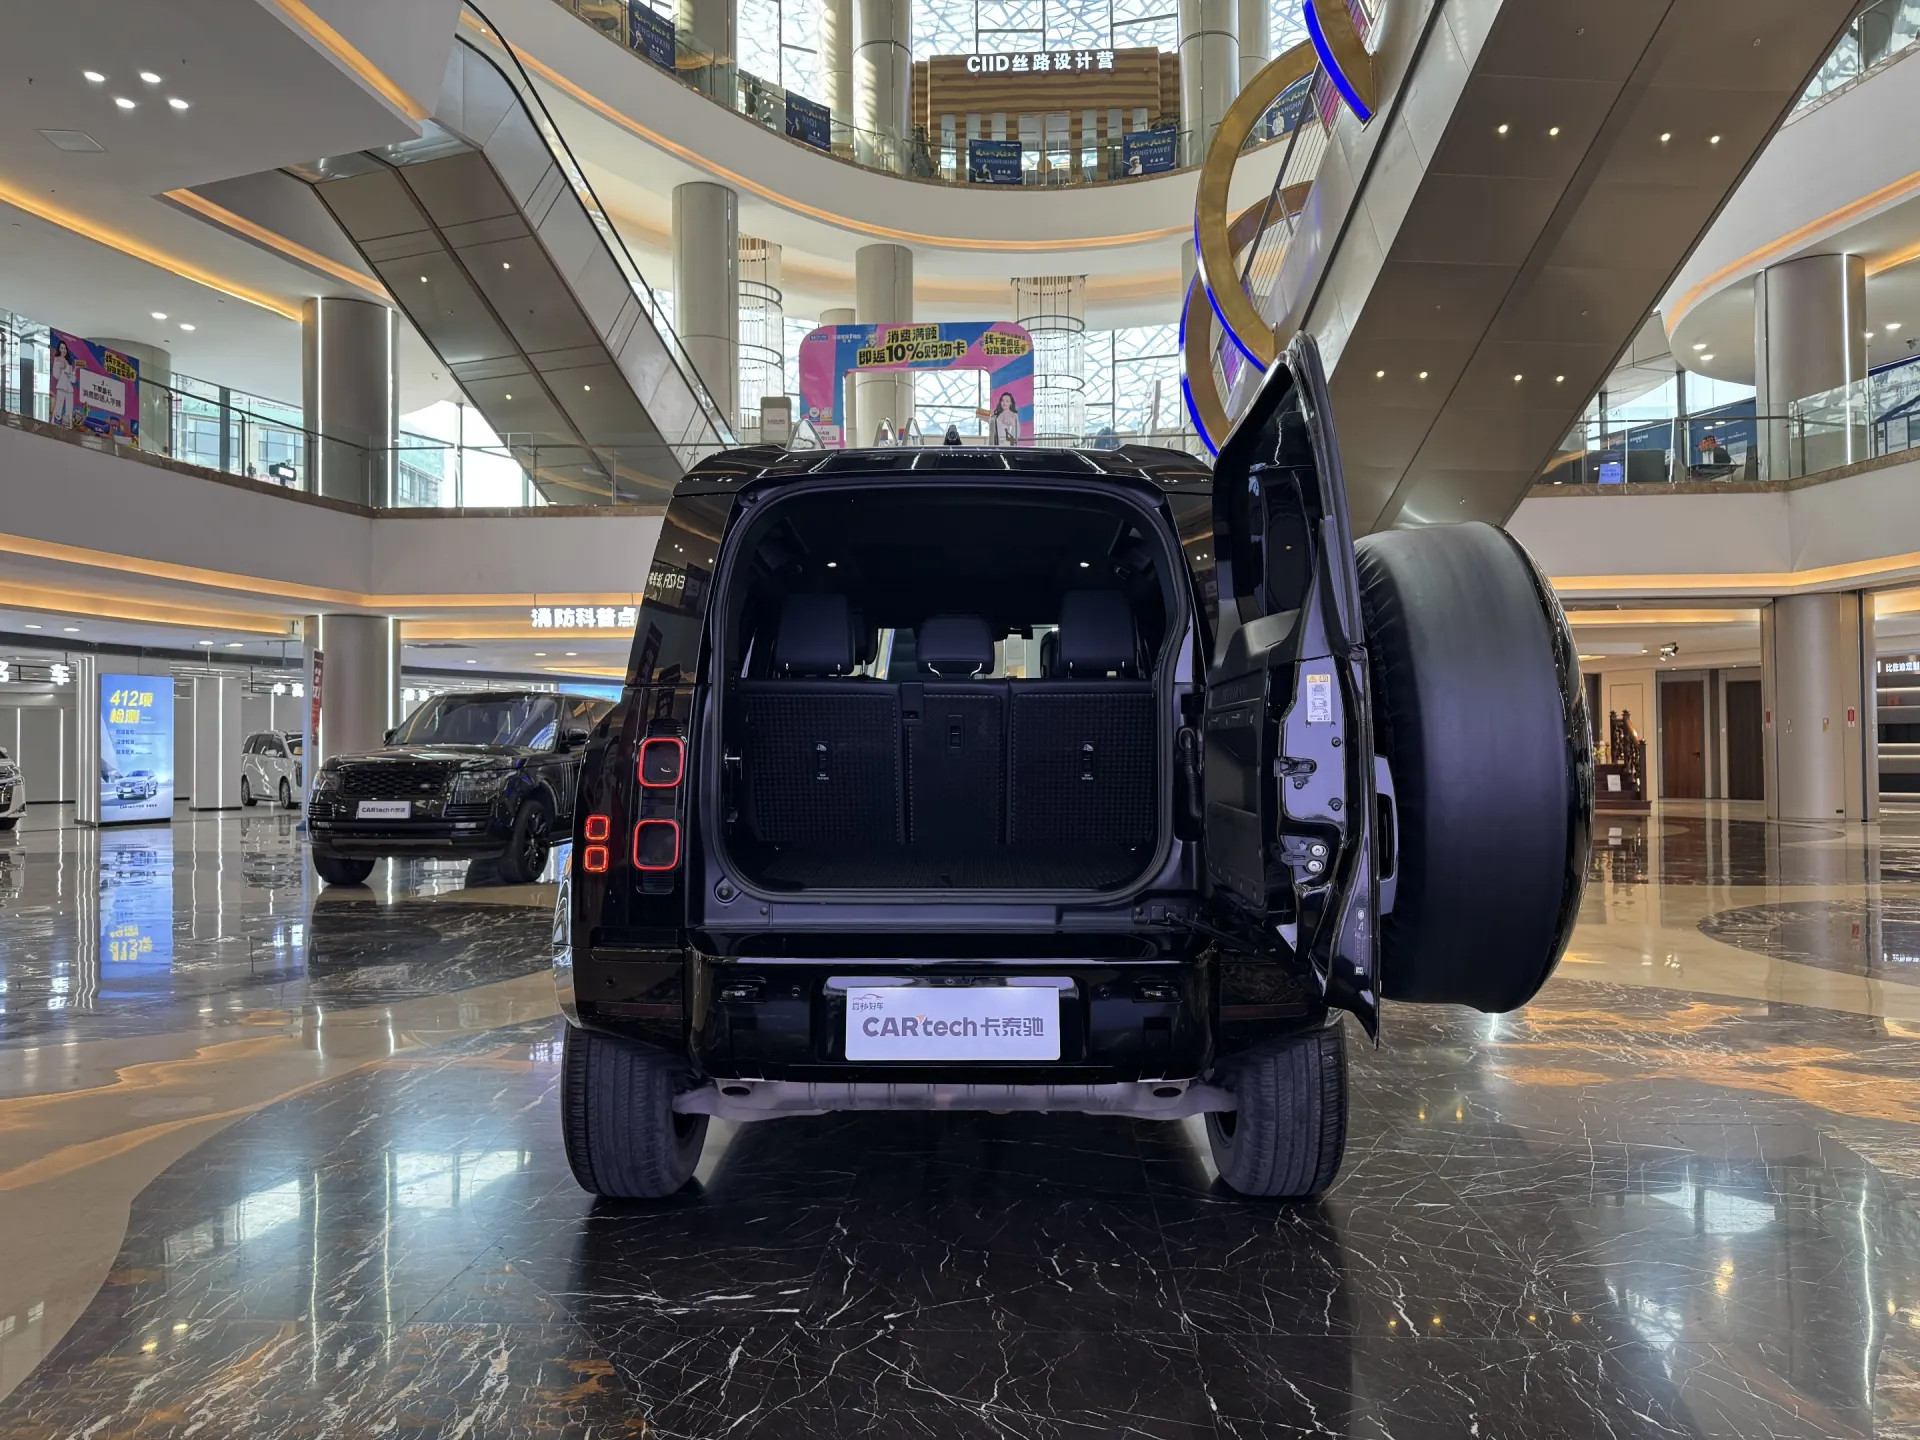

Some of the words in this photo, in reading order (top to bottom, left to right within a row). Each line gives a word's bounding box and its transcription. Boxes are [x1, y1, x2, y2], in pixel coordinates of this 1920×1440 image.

[966, 50, 1115, 73] CIID丝路设计营
[887, 326, 937, 344] 消费满额
[858, 341, 966, 365] 即返10%购物卡
[531, 607, 637, 628] 消防科普点
[109, 689, 154, 707] 412项
[862, 1015, 1044, 1038] CARtech卡泰驰
